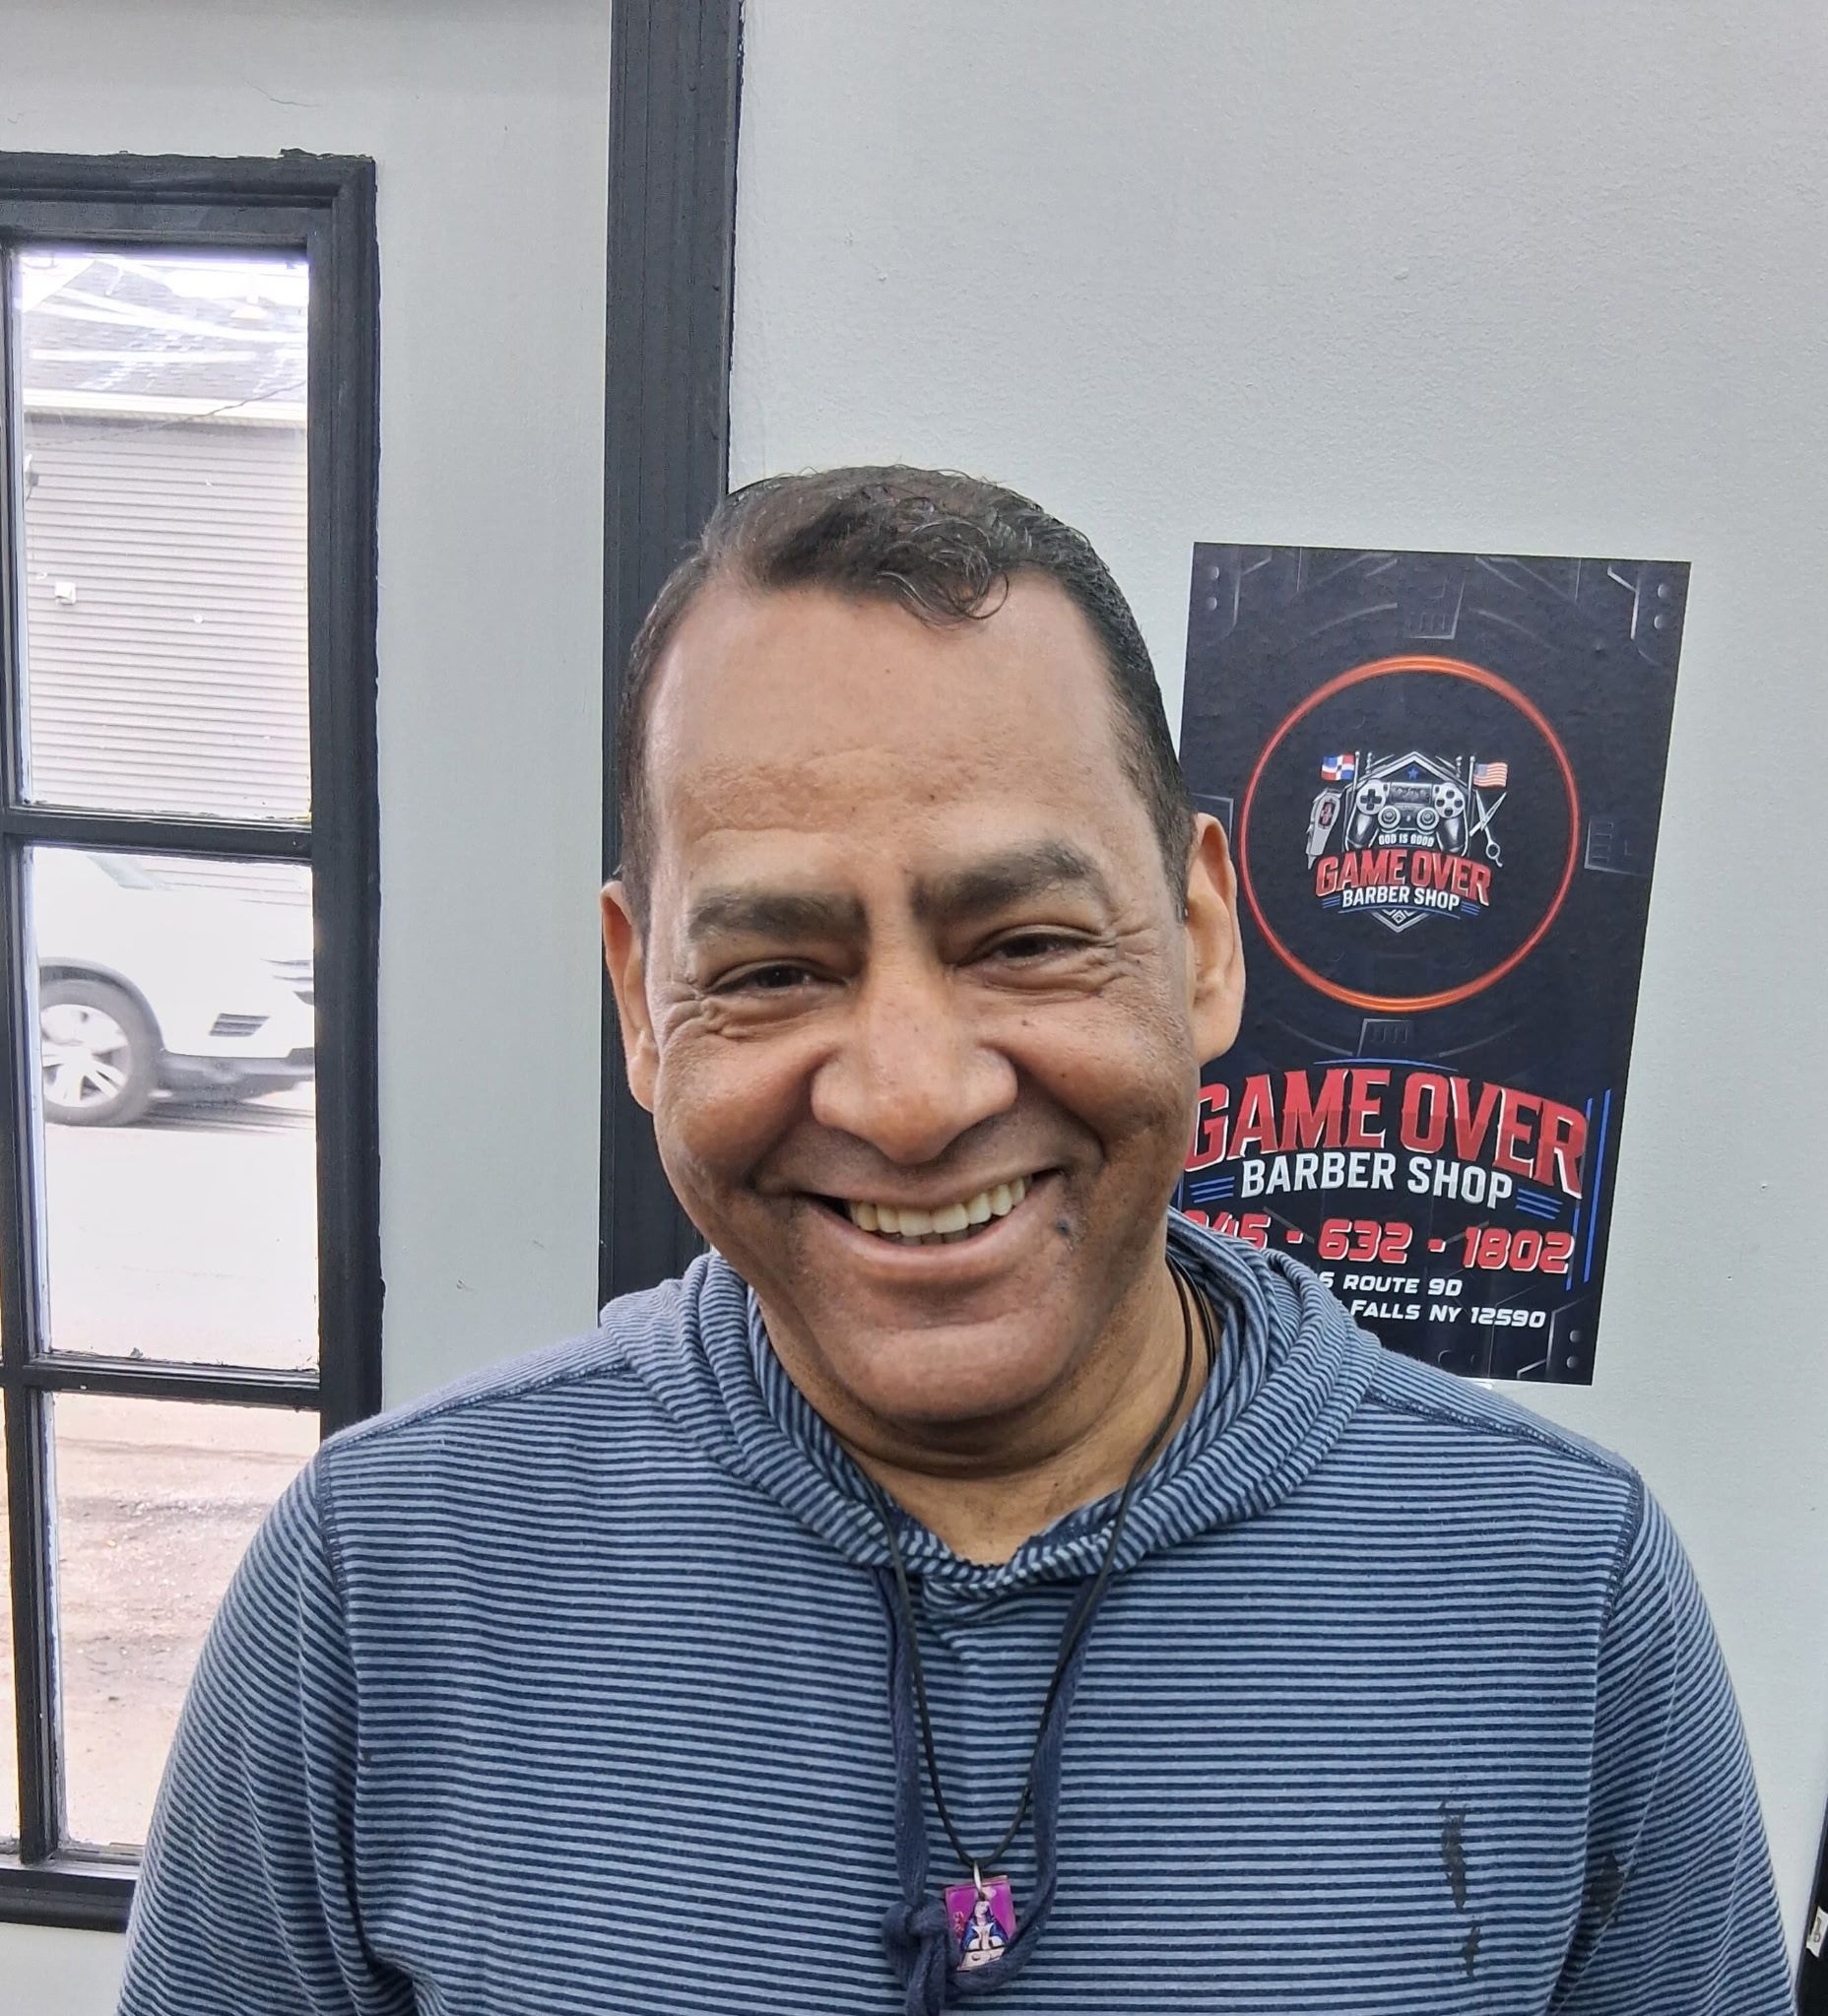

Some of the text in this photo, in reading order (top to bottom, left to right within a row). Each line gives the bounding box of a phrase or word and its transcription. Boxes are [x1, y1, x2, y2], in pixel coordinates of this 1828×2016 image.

[1400, 833, 1408, 844] IS
[1410, 833, 1434, 847] GOOD
[1316, 848, 1491, 906] GAME OVER
[1342, 886, 1460, 911] BARBER SHOP
[1185, 1069, 1589, 1201] GAME OVER
[1241, 1151, 1513, 1209] BARBER SHOP
[1318, 1218, 1412, 1265] 632
[1463, 1226, 1575, 1274] 1802
[1342, 1274, 1420, 1294] ROUTE
[1428, 1278, 1463, 1297] 9D
[1350, 1299, 1546, 1329] FALLS NY 12590
